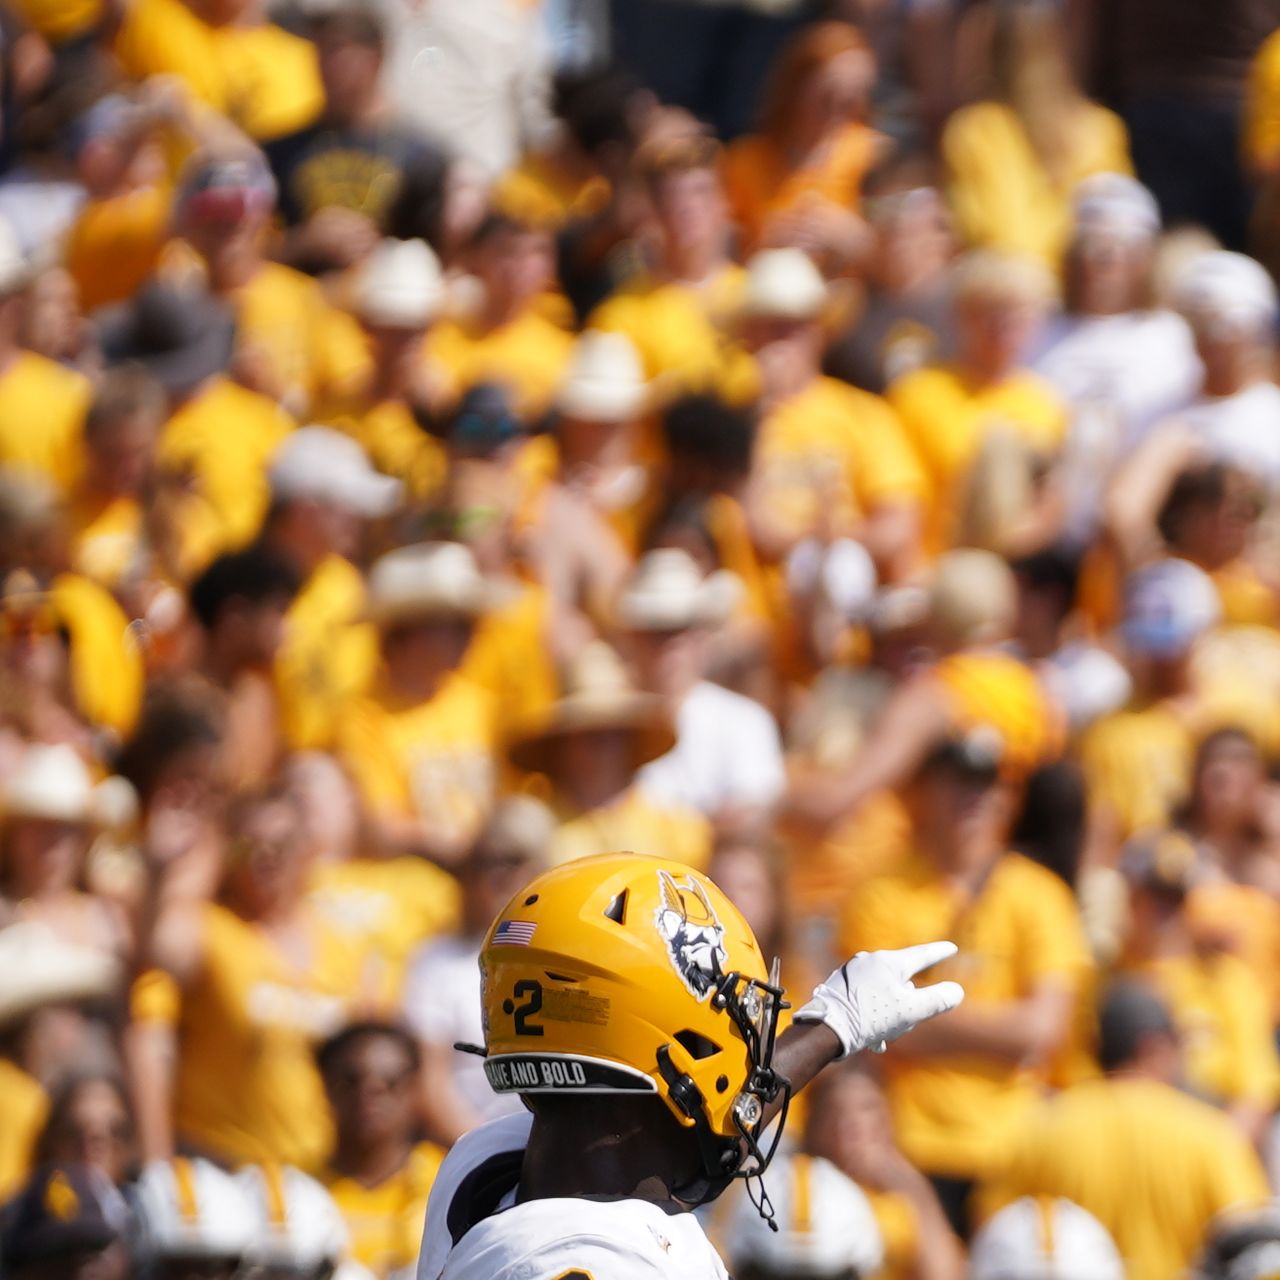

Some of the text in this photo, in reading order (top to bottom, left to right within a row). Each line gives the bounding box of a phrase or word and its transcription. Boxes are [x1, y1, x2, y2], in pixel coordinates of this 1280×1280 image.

[513, 979, 545, 1037] 2
[510, 1060, 540, 1087] AND
[540, 1060, 587, 1086] BOLD
